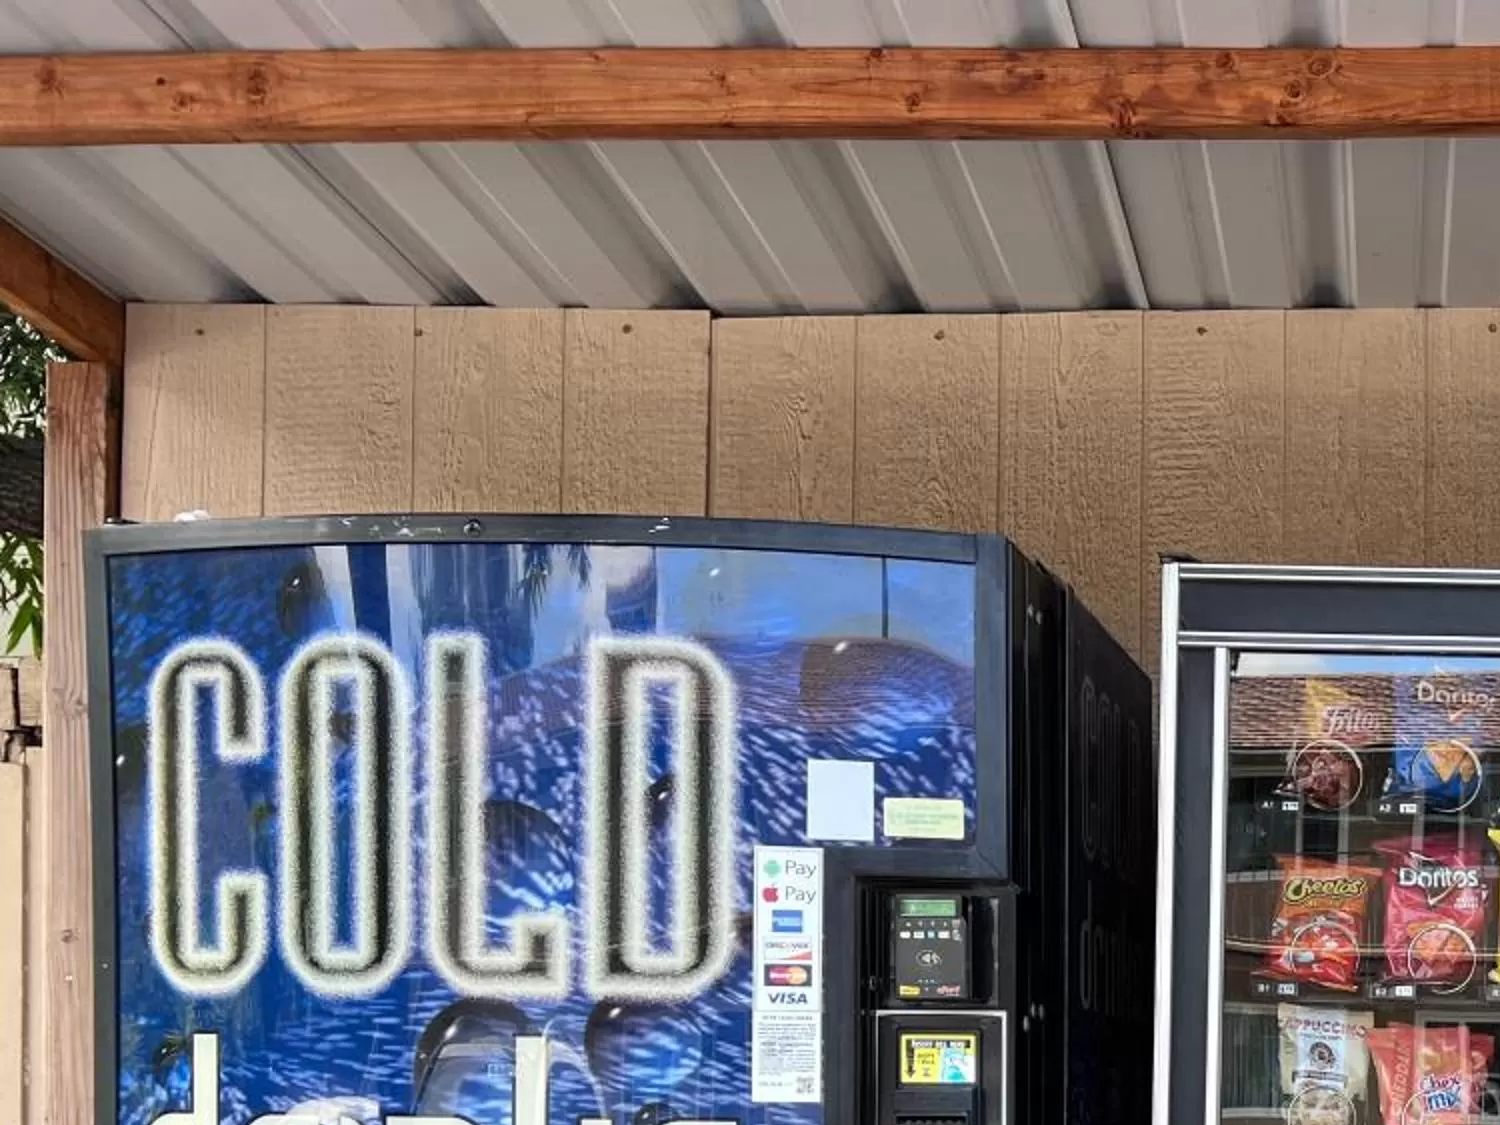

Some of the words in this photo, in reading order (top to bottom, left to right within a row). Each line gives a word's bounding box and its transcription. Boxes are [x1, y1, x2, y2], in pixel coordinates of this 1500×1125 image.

[146, 630, 740, 1000] COLD
[785, 859, 817, 879] Pay
[1399, 866, 1480, 888] Doritos
[785, 886, 817, 905] Pay
[1285, 878, 1366, 902] Cheetos
[768, 993, 809, 1005] VISA
[1419, 1072, 1461, 1092] Chex
